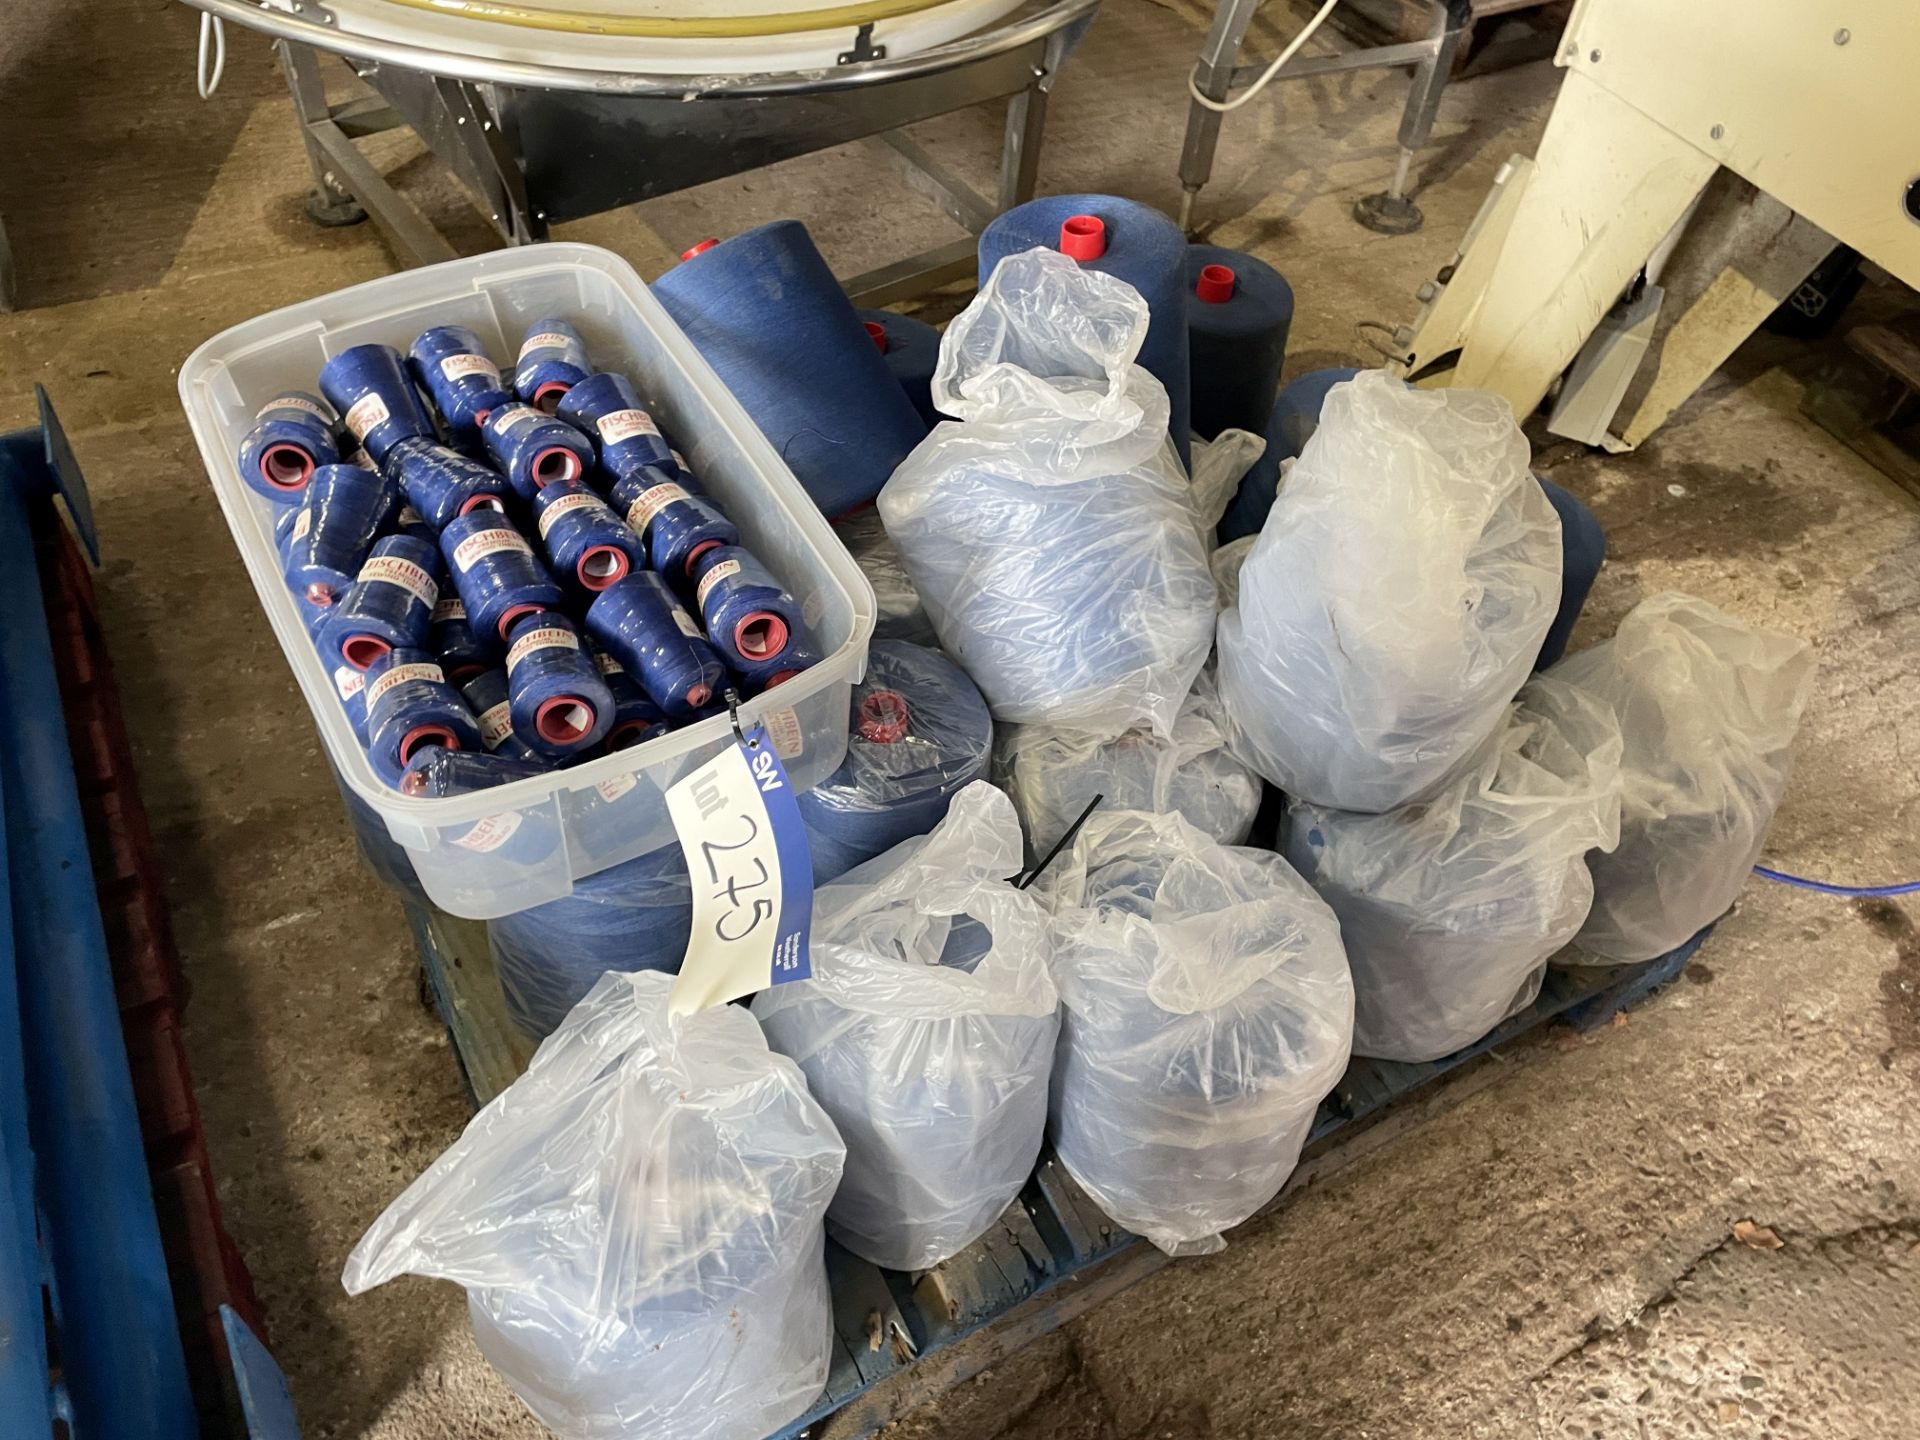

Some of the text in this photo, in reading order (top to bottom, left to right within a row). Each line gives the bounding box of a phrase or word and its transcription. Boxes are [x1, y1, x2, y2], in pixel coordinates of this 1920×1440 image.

[365, 559, 437, 596] FISCHBEIN
[689, 769, 730, 821] Lot
[701, 814, 773, 942] 275
